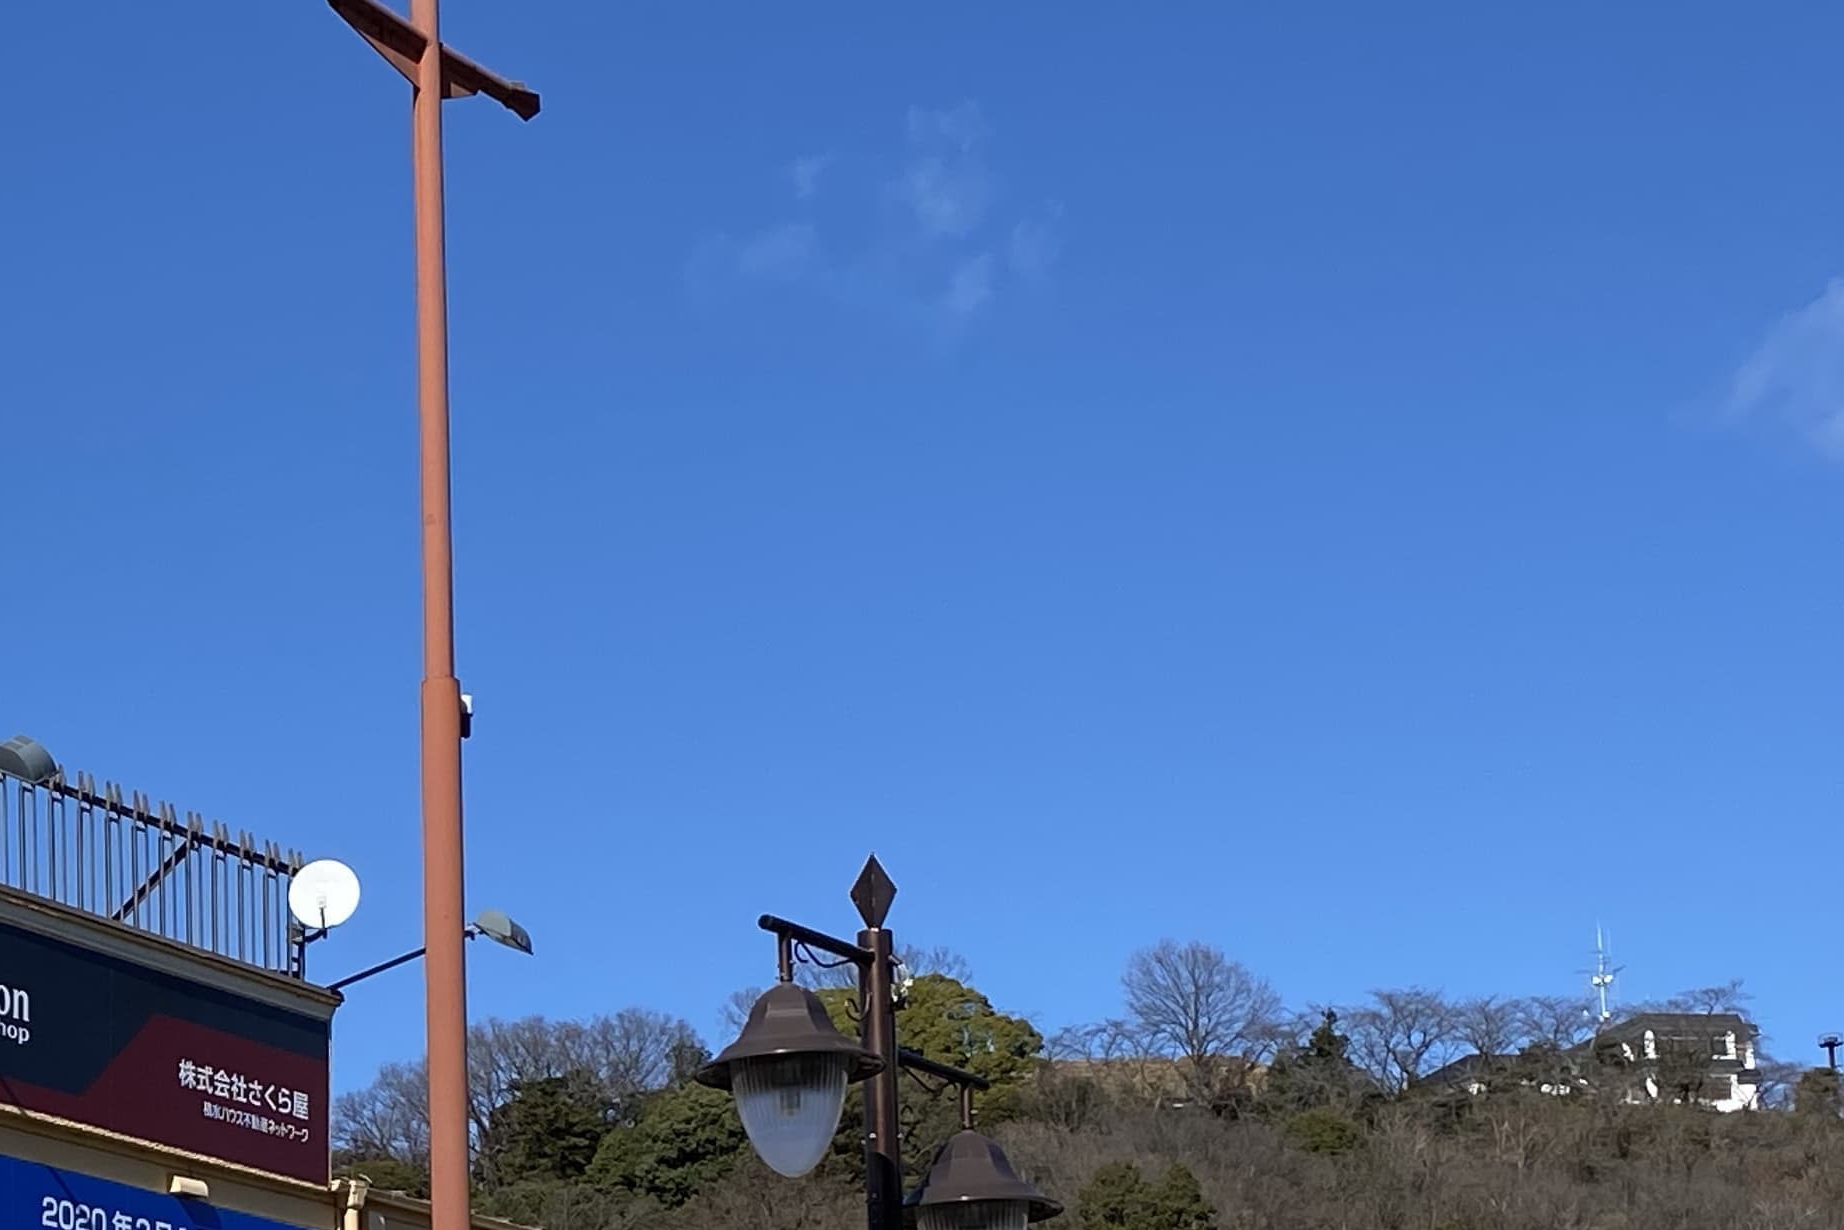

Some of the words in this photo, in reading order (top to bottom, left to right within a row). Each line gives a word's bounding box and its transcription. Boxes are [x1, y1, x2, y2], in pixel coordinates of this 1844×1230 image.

[178, 1058, 308, 1120] 株式会社さくら屋
